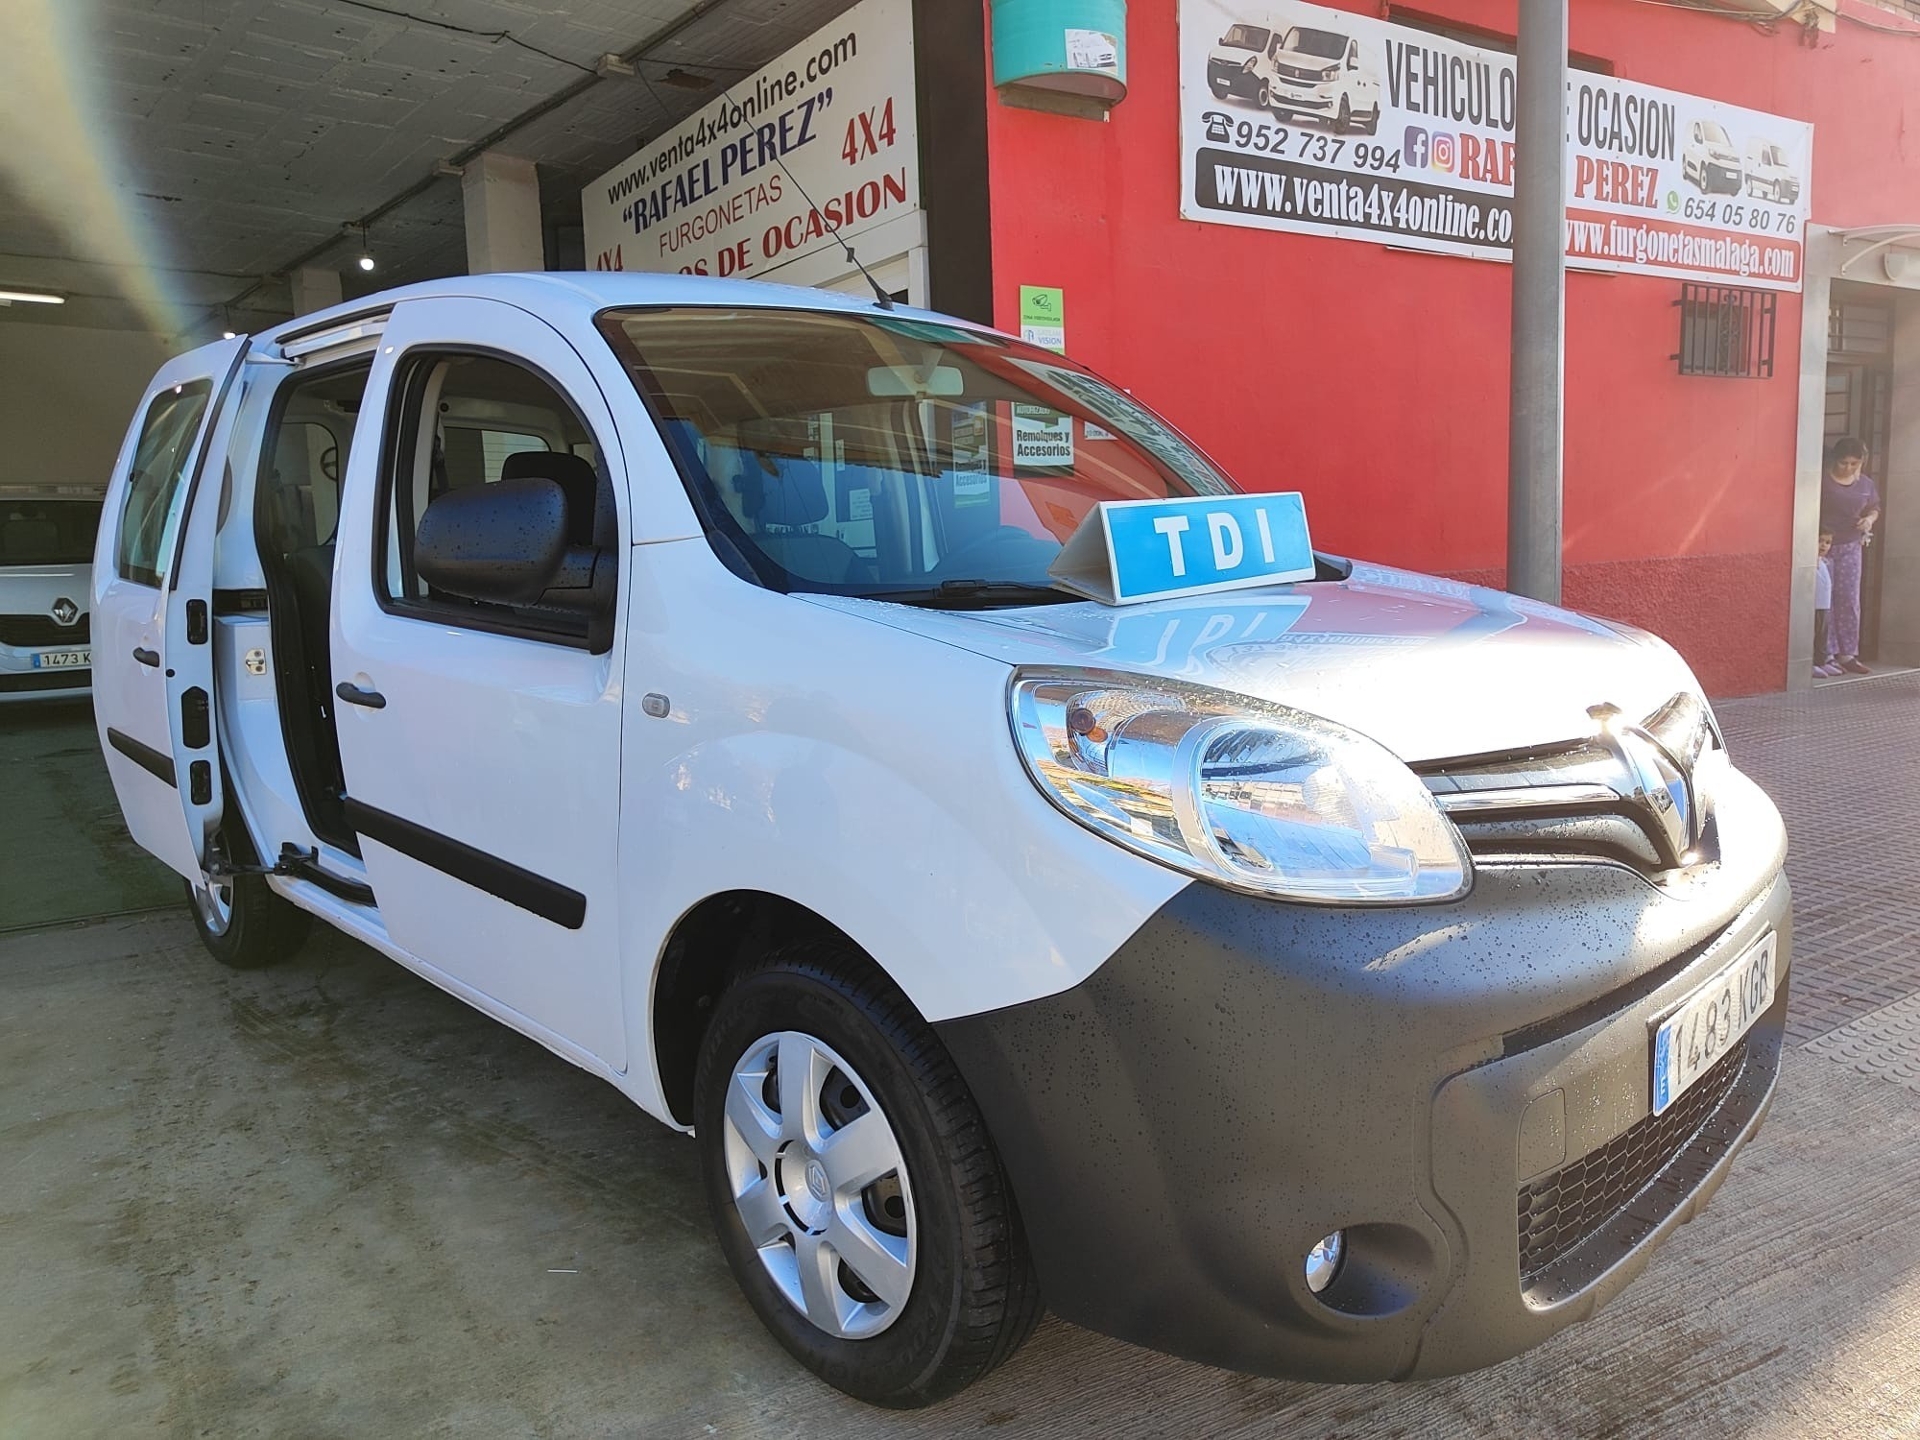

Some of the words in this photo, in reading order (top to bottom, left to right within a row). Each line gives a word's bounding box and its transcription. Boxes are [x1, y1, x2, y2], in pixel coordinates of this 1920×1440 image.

[607, 32, 857, 205] www.venta4x4online.com
[842, 96, 896, 166] 4X4
[1234, 121, 1289, 155] 952
[1298, 131, 1346, 164] 737
[1353, 142, 1401, 174] 994
[1577, 84, 1676, 162] OCASION
[659, 174, 783, 258] FURGONETAS
[1214, 164, 1514, 244] www.venta4x4online.co
[1574, 155, 1660, 209] PEREZ
[1684, 197, 1717, 222] 654
[1722, 203, 1744, 227] 05
[1749, 208, 1770, 231] 80
[1776, 212, 1796, 234] 76
[717, 238, 753, 278] DE
[762, 167, 907, 259] OCASION
[1016, 430, 1063, 443] Remolques
[1065, 432, 1070, 443] y
[1017, 443, 1071, 457] Accesorios
[44, 654, 79, 667] 1473
[1675, 988, 1731, 1086] 1483
